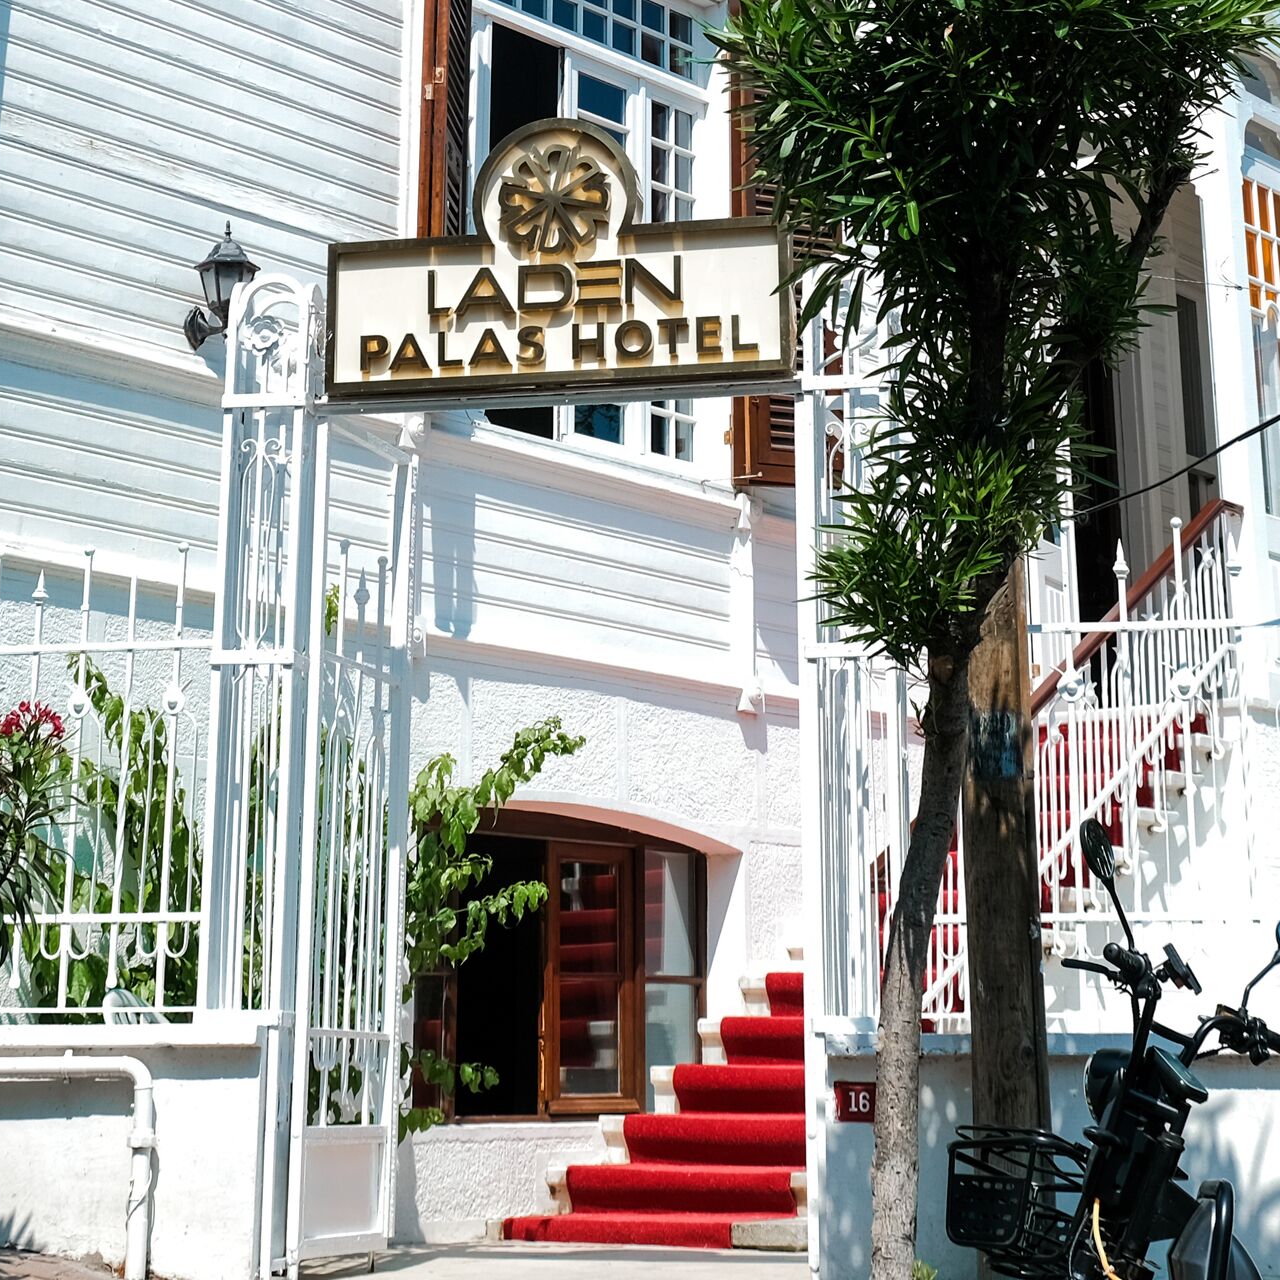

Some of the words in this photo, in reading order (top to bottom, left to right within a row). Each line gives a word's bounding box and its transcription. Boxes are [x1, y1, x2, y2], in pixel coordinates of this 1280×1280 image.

[428, 255, 683, 316] LADEN
[360, 326, 546, 371] PALAS
[572, 315, 758, 360] HOTEL
[849, 1091, 870, 1113] 16
